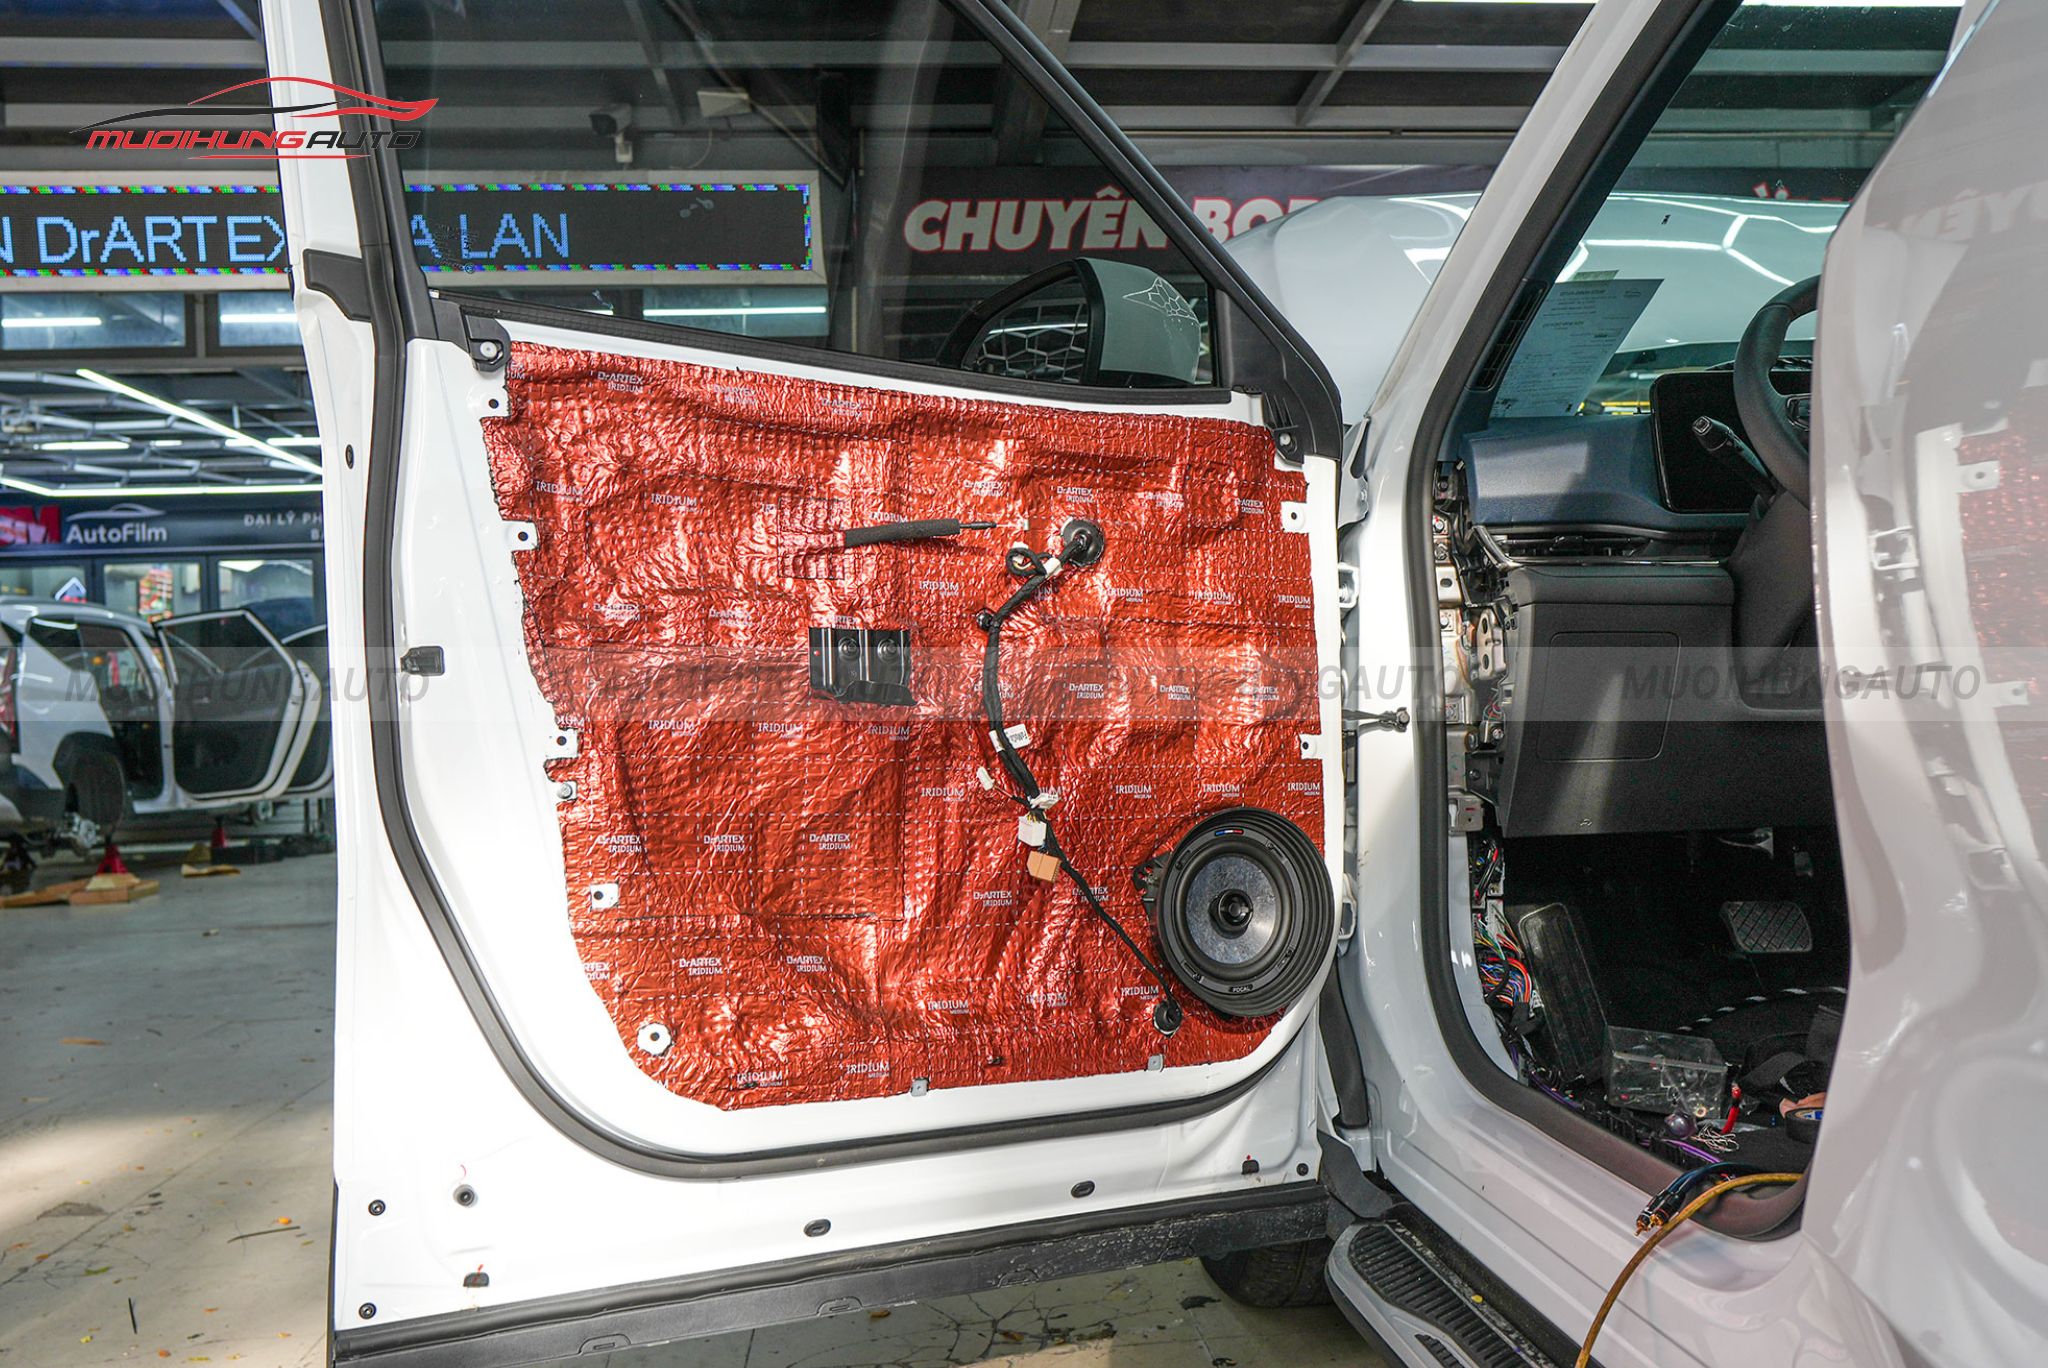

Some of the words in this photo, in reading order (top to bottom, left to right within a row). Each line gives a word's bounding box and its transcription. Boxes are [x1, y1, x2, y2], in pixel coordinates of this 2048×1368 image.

[903, 185, 1167, 253] CHUYÊN
[459, 213, 569, 258] LAN
[66, 522, 168, 544] AutoFilm
[1069, 682, 1105, 692] DrARTEX
[921, 786, 965, 798] IRIDIUM
[1115, 784, 1152, 795] IRIDIUM
[1203, 783, 1240, 794] IRIDIUM
[1287, 782, 1320, 792] IRIDIUM
[809, 833, 850, 843] DrARTEX
[818, 842, 851, 851] IRIDIUM
[678, 957, 722, 968] DrARTEX
[688, 966, 723, 976] IRIDIUM
[846, 1060, 890, 1074] IRIDIUM
